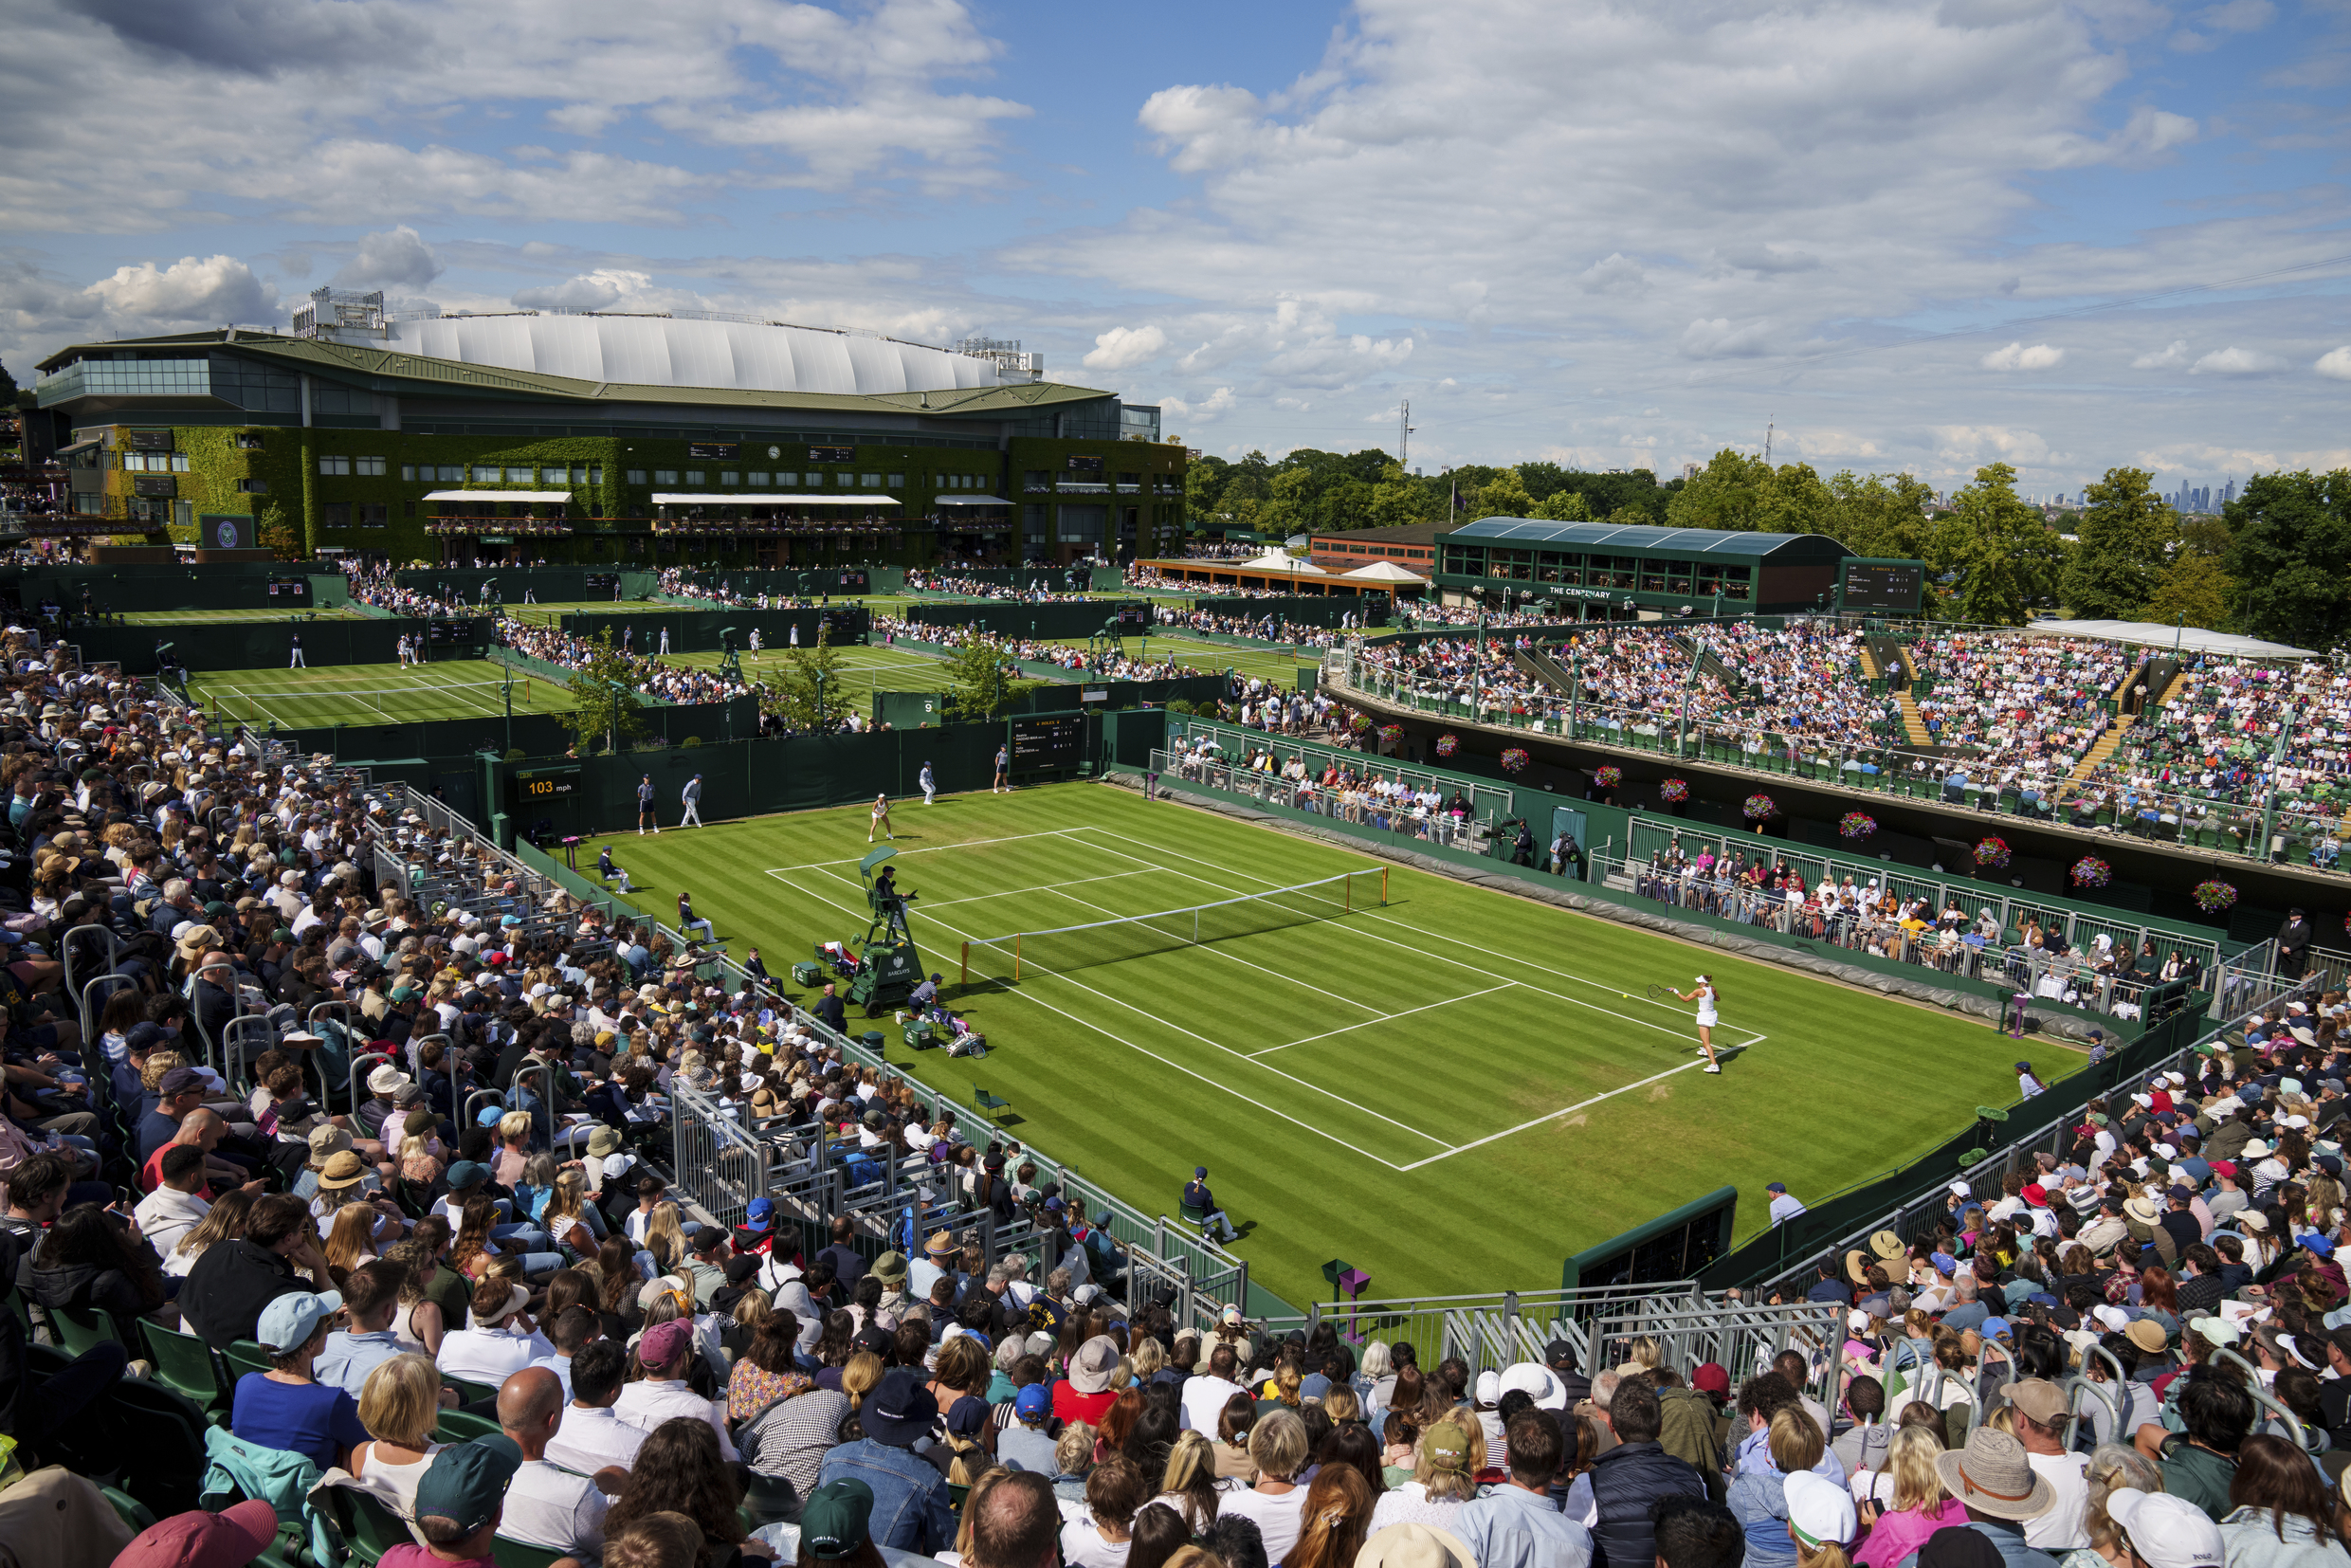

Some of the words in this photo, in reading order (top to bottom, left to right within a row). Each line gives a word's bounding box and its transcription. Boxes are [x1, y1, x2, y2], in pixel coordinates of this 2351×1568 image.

[1566, 588, 1610, 598] CENEARY
[925, 703, 932, 713] 9
[726, 713, 729, 722] 8
[529, 781, 553, 794] 103
[888, 968, 910, 977] BARCLAYS
[422, 1506, 458, 1515] WIMBLEDON
